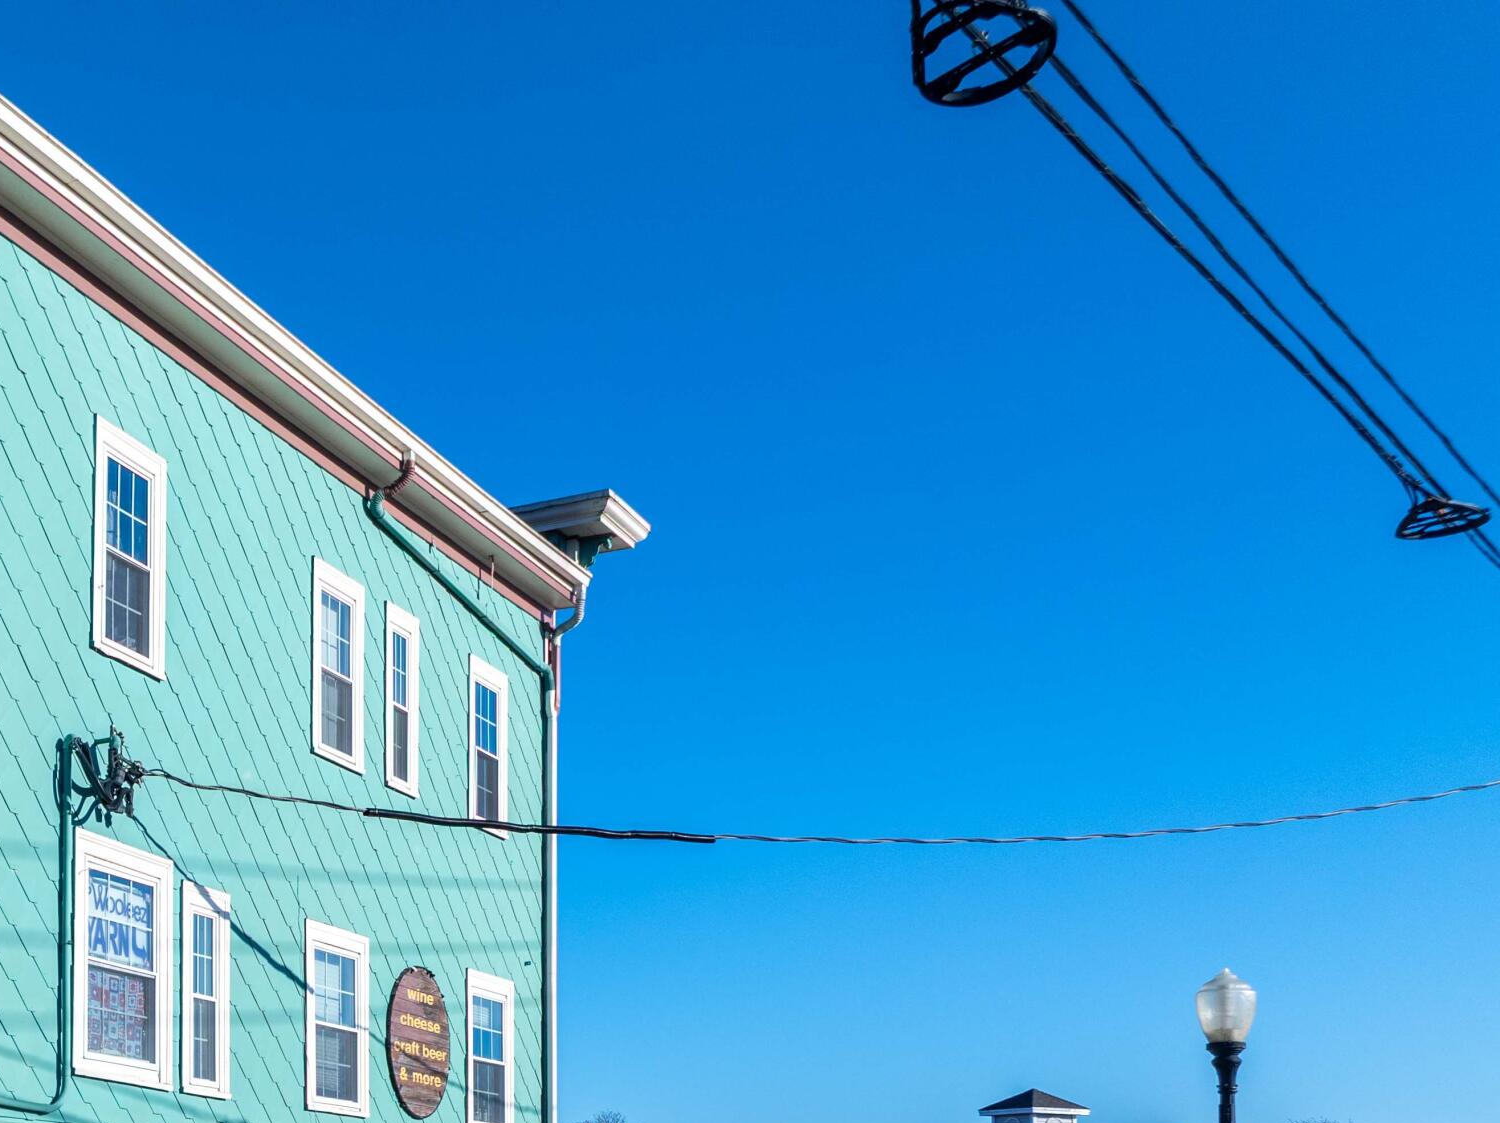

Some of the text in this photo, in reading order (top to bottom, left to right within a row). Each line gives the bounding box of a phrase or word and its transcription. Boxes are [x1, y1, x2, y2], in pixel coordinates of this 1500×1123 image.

[88, 917, 130, 957] YARN
[407, 988, 434, 1006] wine
[400, 1014, 441, 1034] cheese
[394, 1039, 447, 1061] craft beer
[399, 1067, 442, 1087] & more
